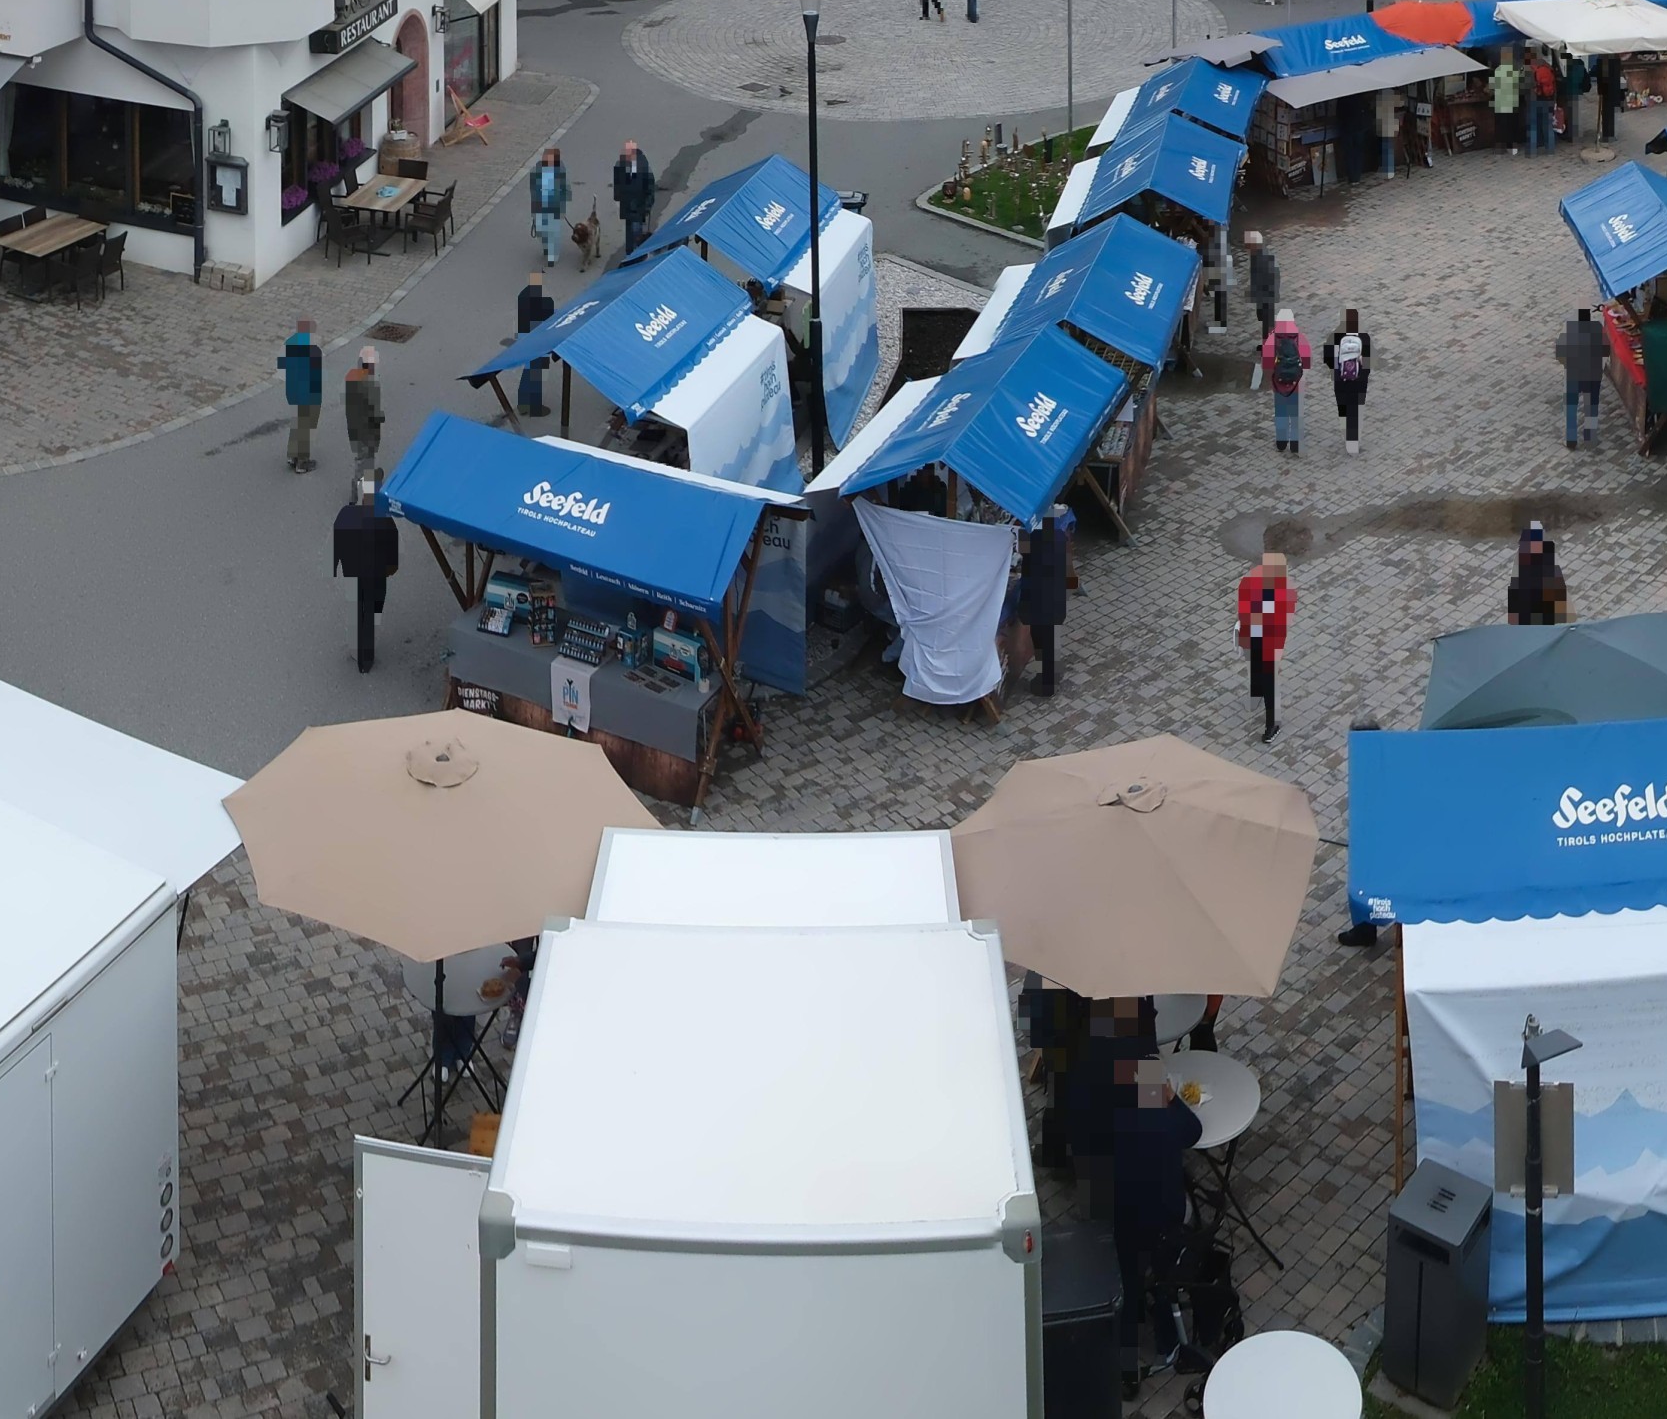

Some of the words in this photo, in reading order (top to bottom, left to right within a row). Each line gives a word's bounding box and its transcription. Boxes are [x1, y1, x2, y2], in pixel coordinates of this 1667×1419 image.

[1324, 35, 1367, 51] Seefeld
[1213, 82, 1233, 103] Seefeld
[1188, 156, 1208, 182] Seefeld
[756, 201, 786, 231] Seefeld
[1608, 215, 1637, 242] Seefeld
[1124, 271, 1154, 306] Seefeld
[634, 304, 678, 343] Seefeld
[1015, 391, 1057, 439] Seefeld
[524, 480, 611, 526] Seefeld
[517, 506, 542, 520] TIROLS
[543, 513, 596, 538] HOCHPLATEAU
[458, 686, 499, 702] DIENSTAGS-
[1556, 834, 1596, 847] TIROLS
[1368, 897, 1392, 907] #tirols
[1369, 909, 1396, 920] plateau
[1372, 903, 1392, 913] hoch
